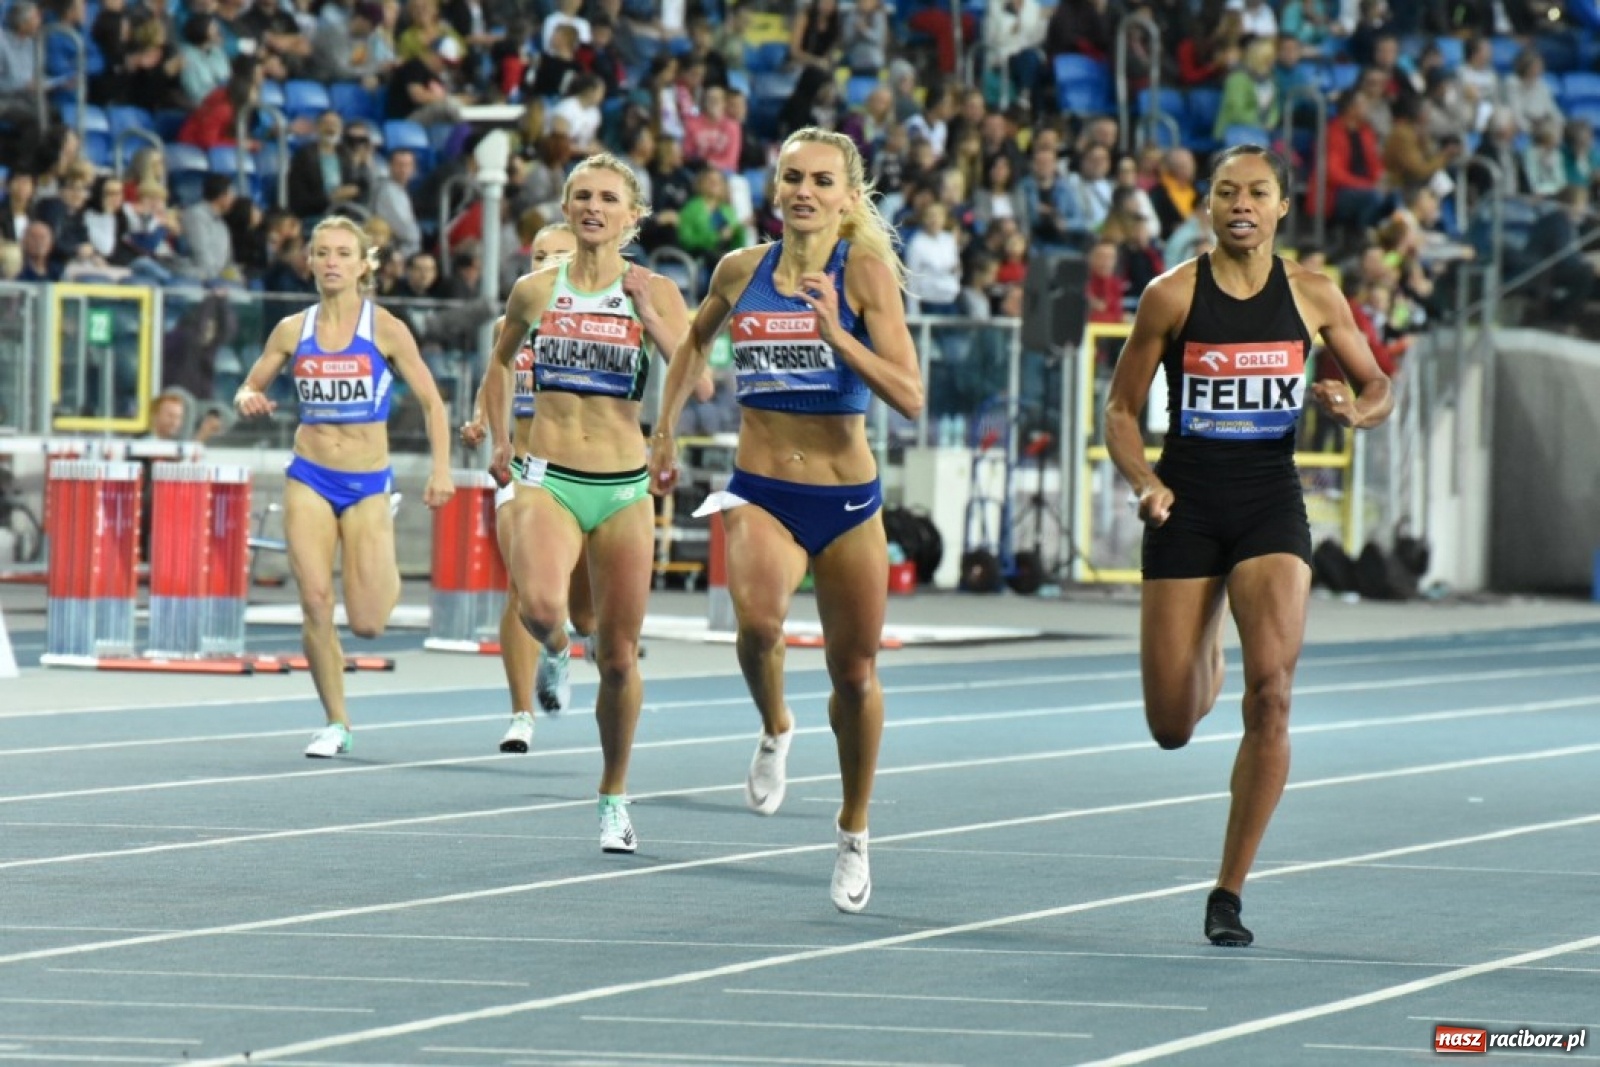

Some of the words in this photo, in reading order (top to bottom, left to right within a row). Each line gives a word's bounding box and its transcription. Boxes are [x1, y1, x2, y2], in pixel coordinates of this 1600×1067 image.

[583, 323, 623, 335] ORLEN
[769, 319, 810, 331] ORLEN
[1239, 354, 1284, 366] ORLEN
[325, 362, 355, 371] ORLEN
[299, 379, 368, 402] GAJDA
[1187, 377, 1299, 411] FELIX
